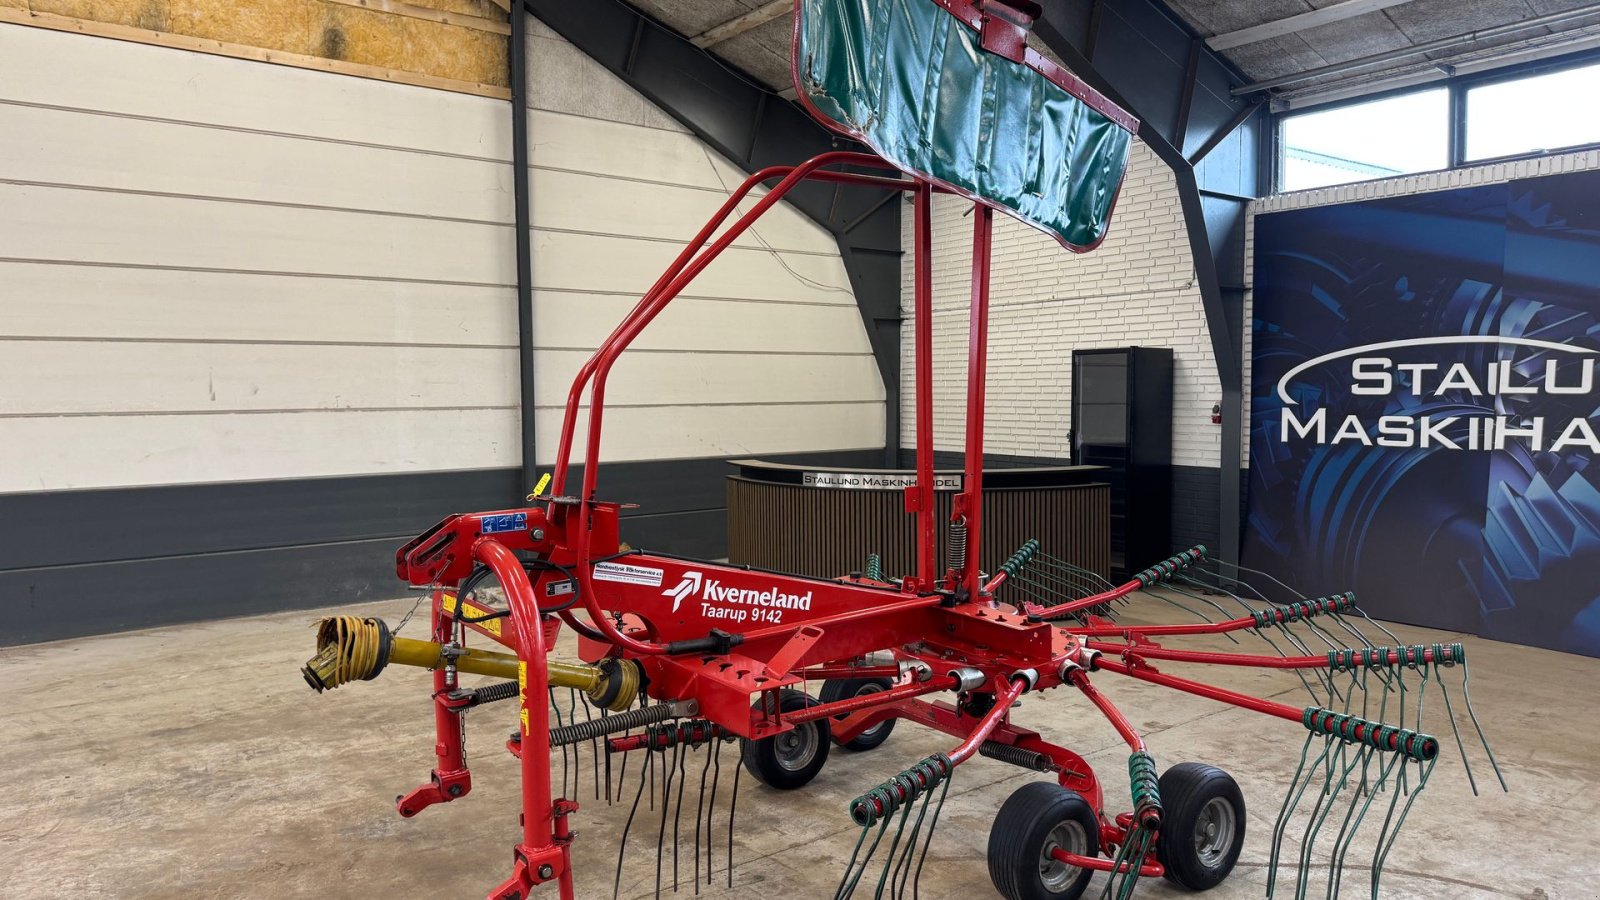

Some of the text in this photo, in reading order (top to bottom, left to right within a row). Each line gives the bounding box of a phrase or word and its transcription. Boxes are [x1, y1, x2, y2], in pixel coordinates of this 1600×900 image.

[804, 475, 959, 487] STAULUND MASKINHDEL
[702, 579, 813, 611] Kverneland
[701, 602, 783, 624] Taarup 9142
